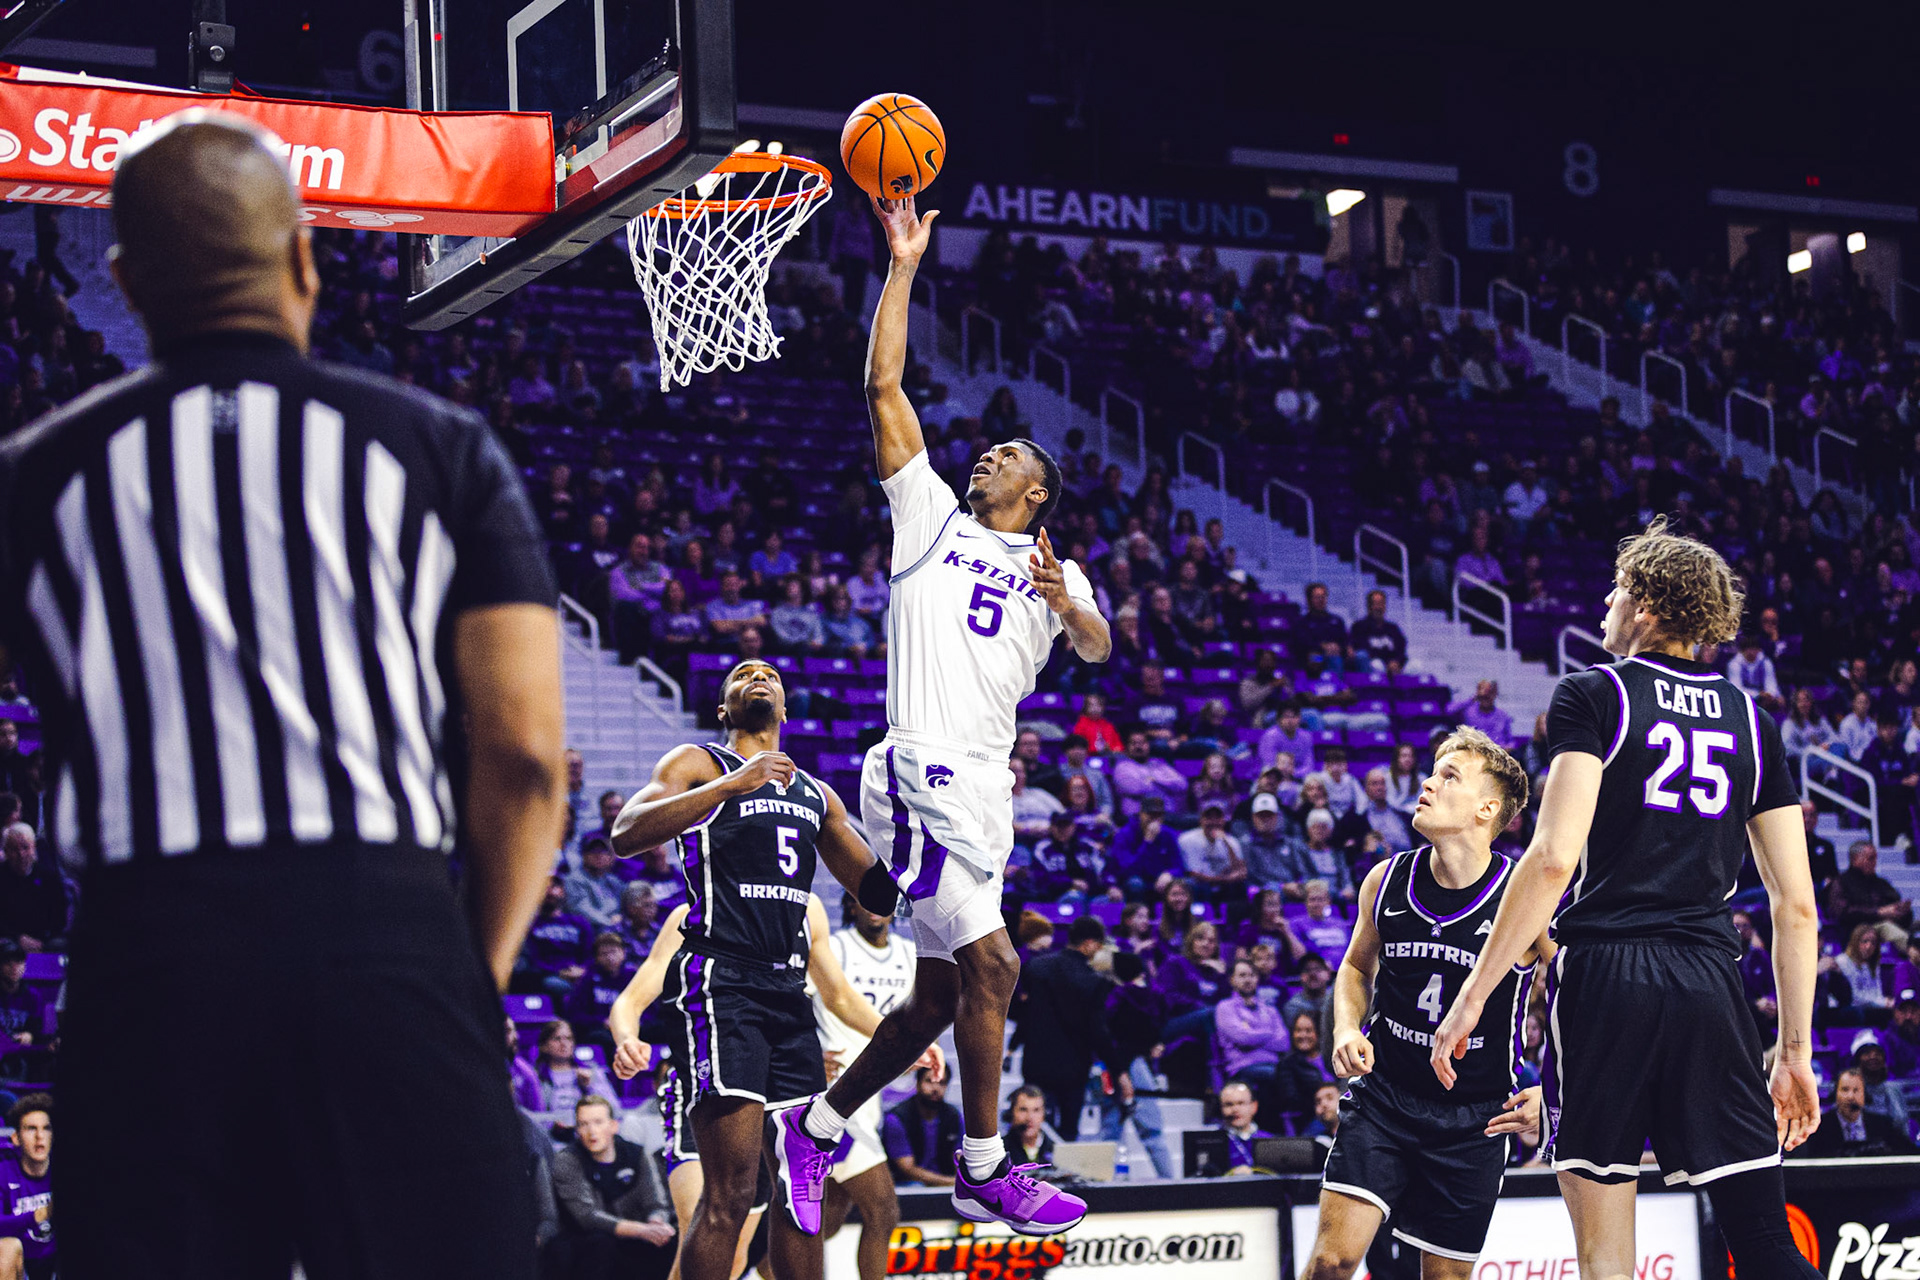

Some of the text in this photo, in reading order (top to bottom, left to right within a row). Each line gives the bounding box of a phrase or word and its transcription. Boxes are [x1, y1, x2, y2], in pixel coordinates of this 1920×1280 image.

[1563, 142, 1598, 197] 8
[943, 550, 1042, 603] K-STATE
[967, 582, 1008, 637] 5
[1654, 678, 1722, 719] CATO
[967, 749, 990, 762] FAMILY
[1643, 719, 1738, 820] 25
[776, 825, 800, 878] 5
[1384, 941, 1480, 970] CENTRA
[1417, 973, 1444, 1025] 4
